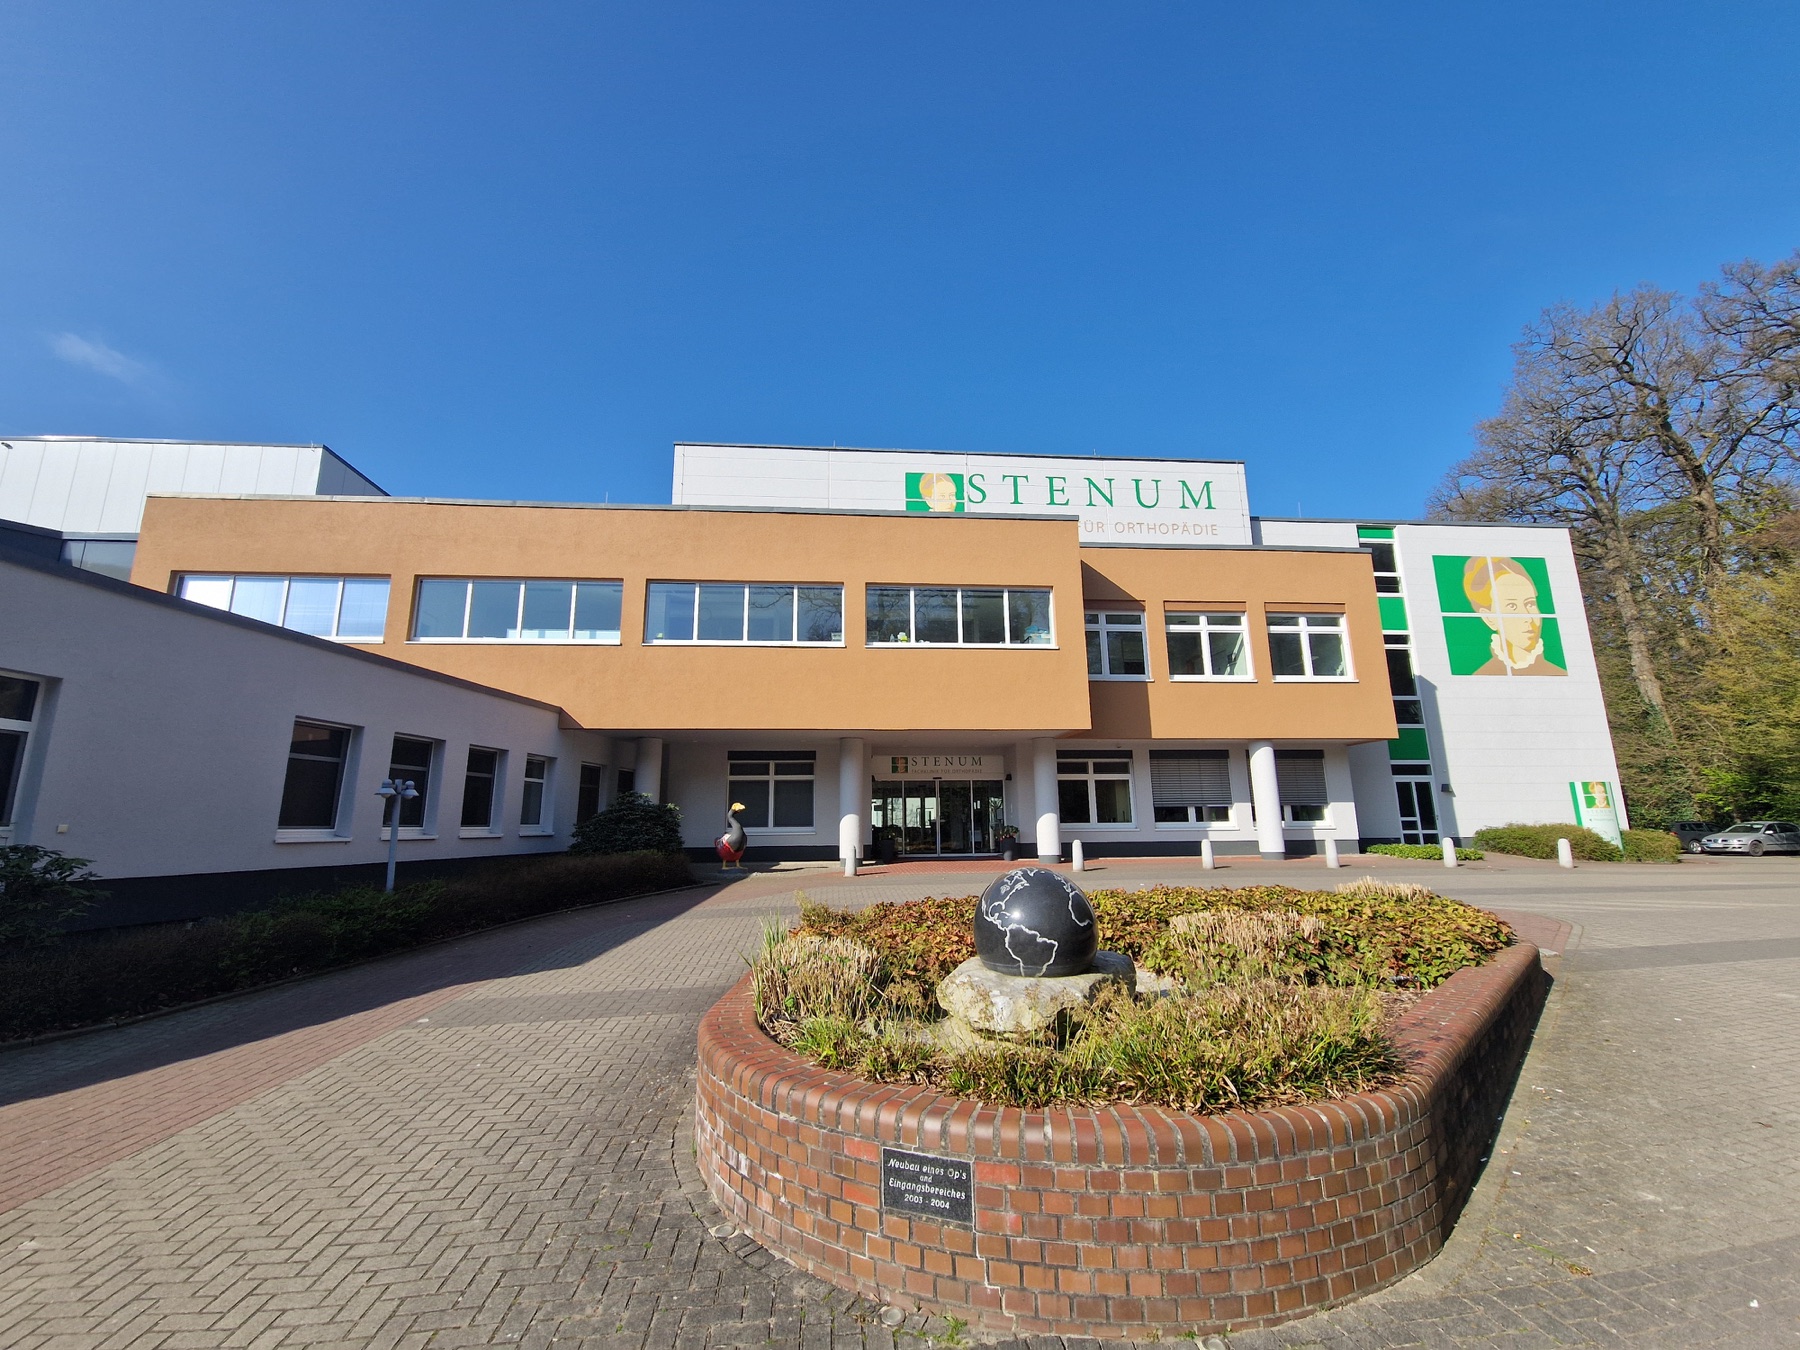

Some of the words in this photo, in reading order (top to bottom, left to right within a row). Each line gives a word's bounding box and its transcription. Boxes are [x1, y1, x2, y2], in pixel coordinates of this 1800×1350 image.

[967, 473, 1217, 510] STENUM
[1114, 521, 1219, 536] ORTHOPÄDIE
[911, 756, 983, 766] STENUM
[888, 1158, 920, 1172] Neubau
[922, 1165, 944, 1176] eines
[888, 1177, 966, 1200] Eingangsbereiches
[904, 1193, 923, 1204] 2003
[930, 1198, 950, 1210] 2004
